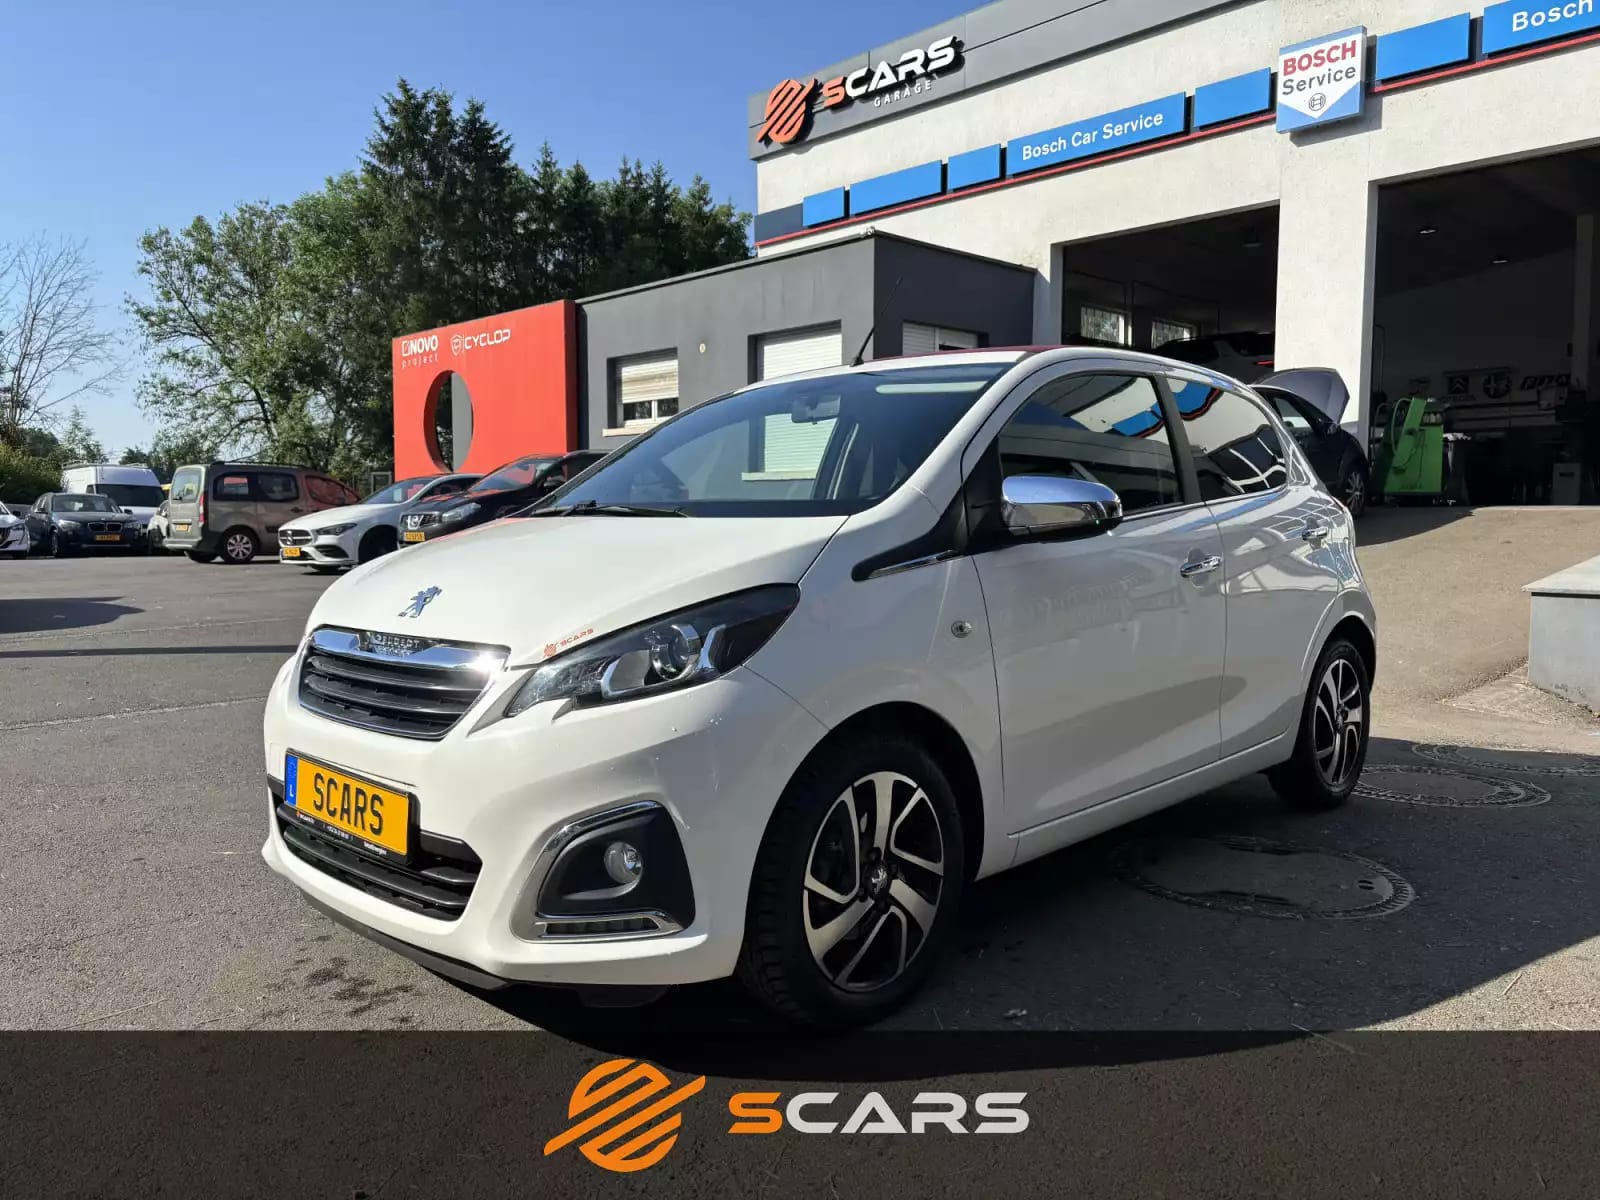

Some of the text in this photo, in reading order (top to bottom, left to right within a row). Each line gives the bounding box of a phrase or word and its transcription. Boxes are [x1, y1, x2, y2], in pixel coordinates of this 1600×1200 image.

[1512, 0, 1593, 32] Bosch
[822, 35, 956, 108] SCARS
[1283, 39, 1357, 77] BOSCH
[873, 79, 933, 108] GARAGE
[1282, 66, 1357, 96] Service
[1022, 113, 1164, 161] Bosch Car Service
[289, 783, 295, 798] L
[313, 772, 384, 836] SCARS
